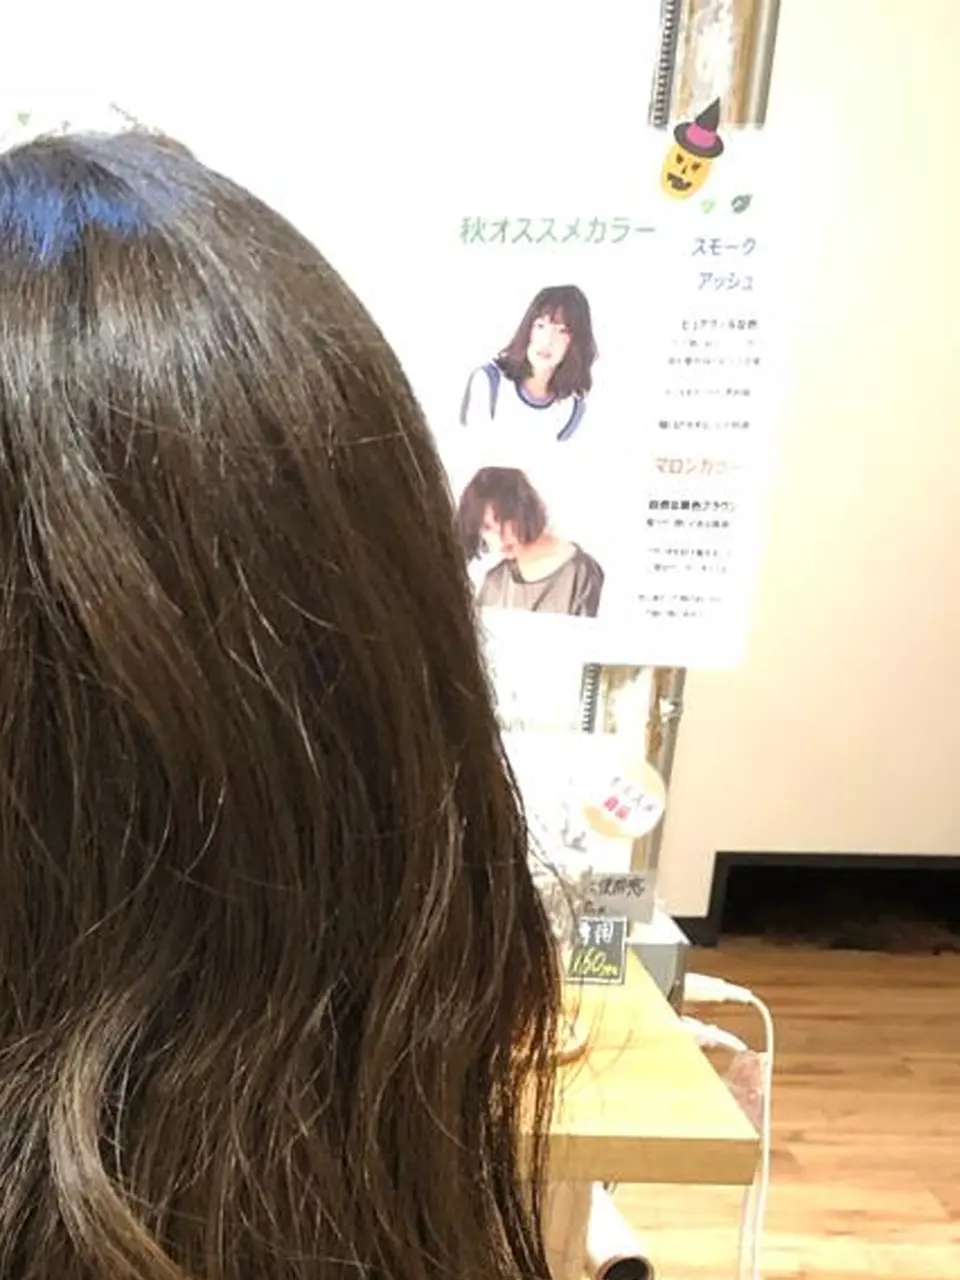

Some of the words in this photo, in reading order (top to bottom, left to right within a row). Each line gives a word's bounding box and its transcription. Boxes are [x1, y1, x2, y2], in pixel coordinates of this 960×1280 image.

[459, 215, 656, 244] 秋オススメカラー
[691, 236, 757, 256] スモーク
[697, 271, 754, 291] アッシュ
